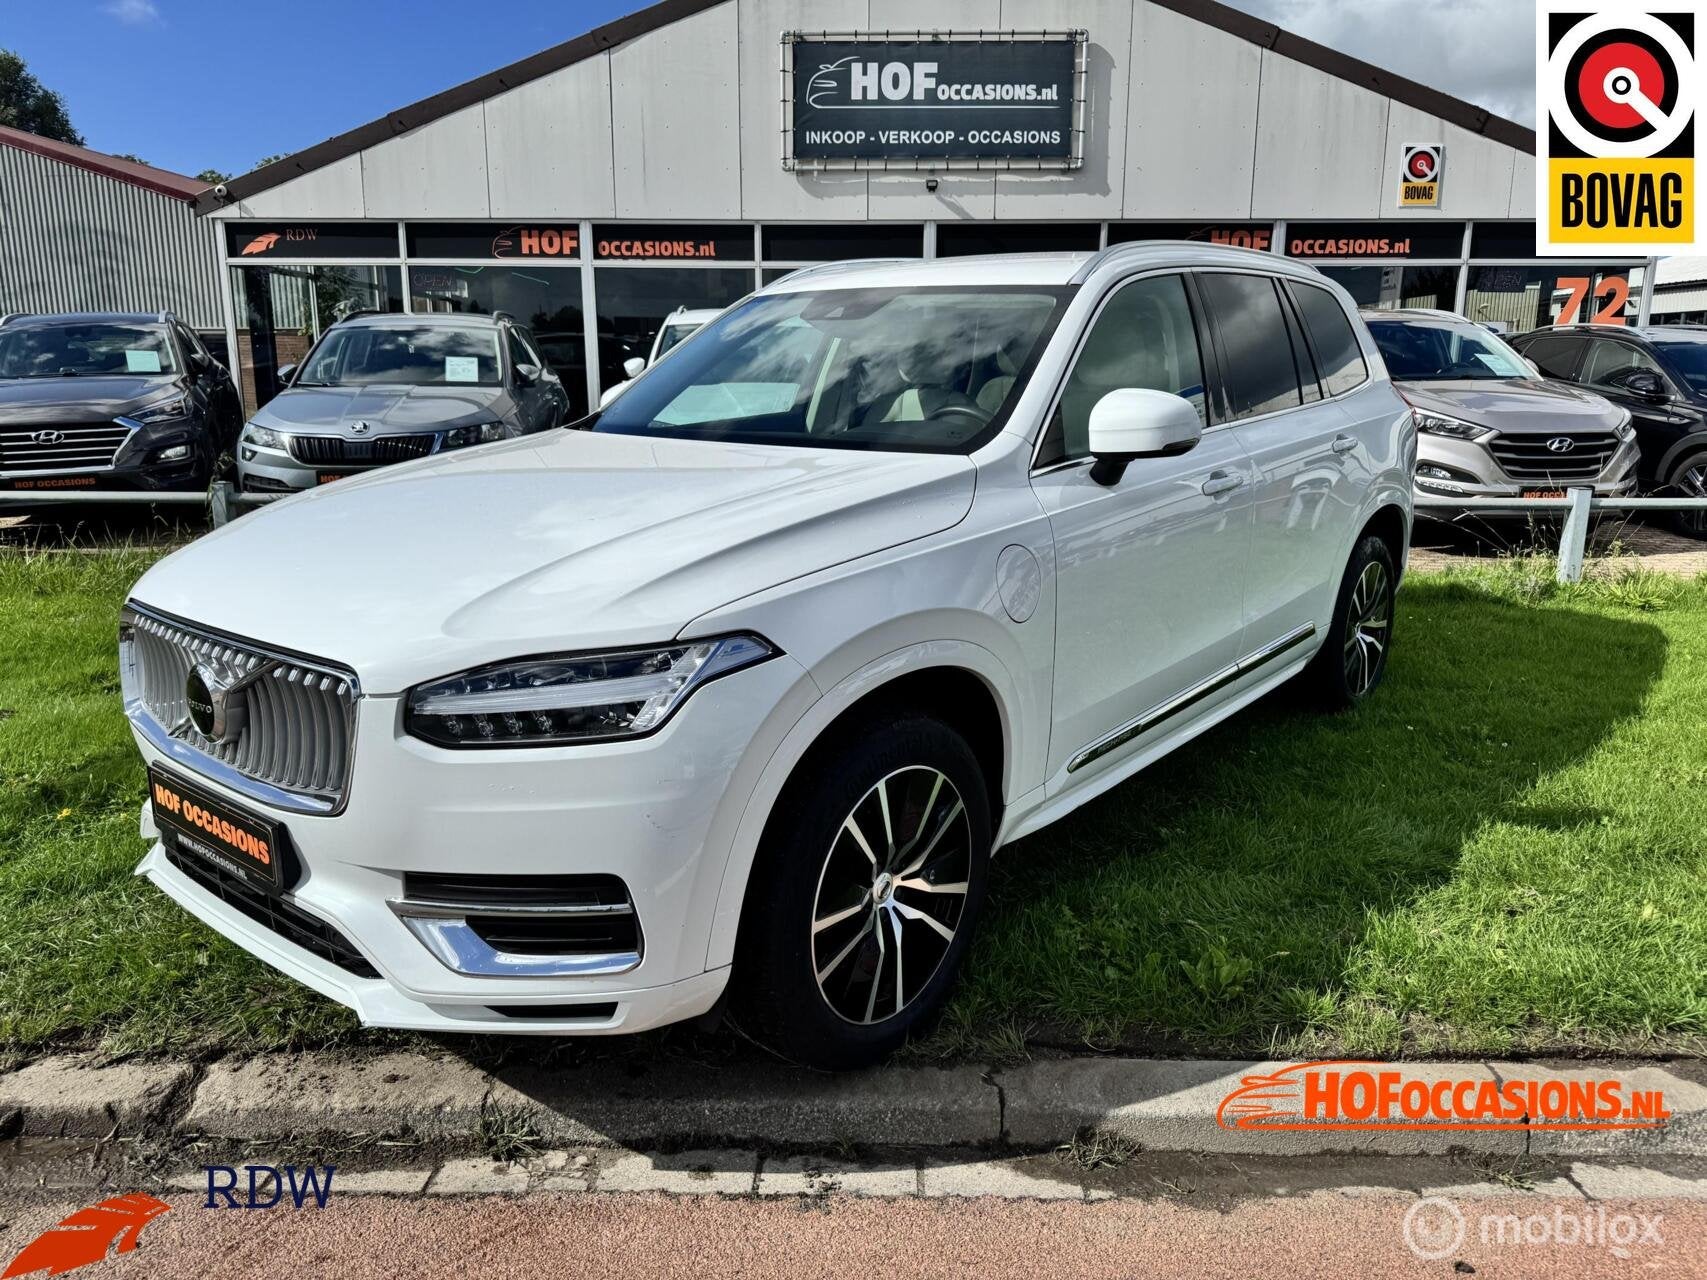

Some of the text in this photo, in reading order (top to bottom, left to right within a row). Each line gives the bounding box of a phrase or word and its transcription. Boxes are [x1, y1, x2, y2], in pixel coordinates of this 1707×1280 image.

[805, 130, 866, 145] INKOOP
[878, 130, 955, 145] VERKOOP
[967, 130, 1062, 145] OCCASIONS
[1404, 185, 1434, 200] BOVAG
[286, 229, 318, 241] RDW
[520, 230, 716, 257] HOF OCCASIONS.nl
[1210, 230, 1411, 254] HOF OCCASIONS.nl
[1555, 276, 1630, 326] 72
[154, 782, 270, 865] HOF OCCASIONS
